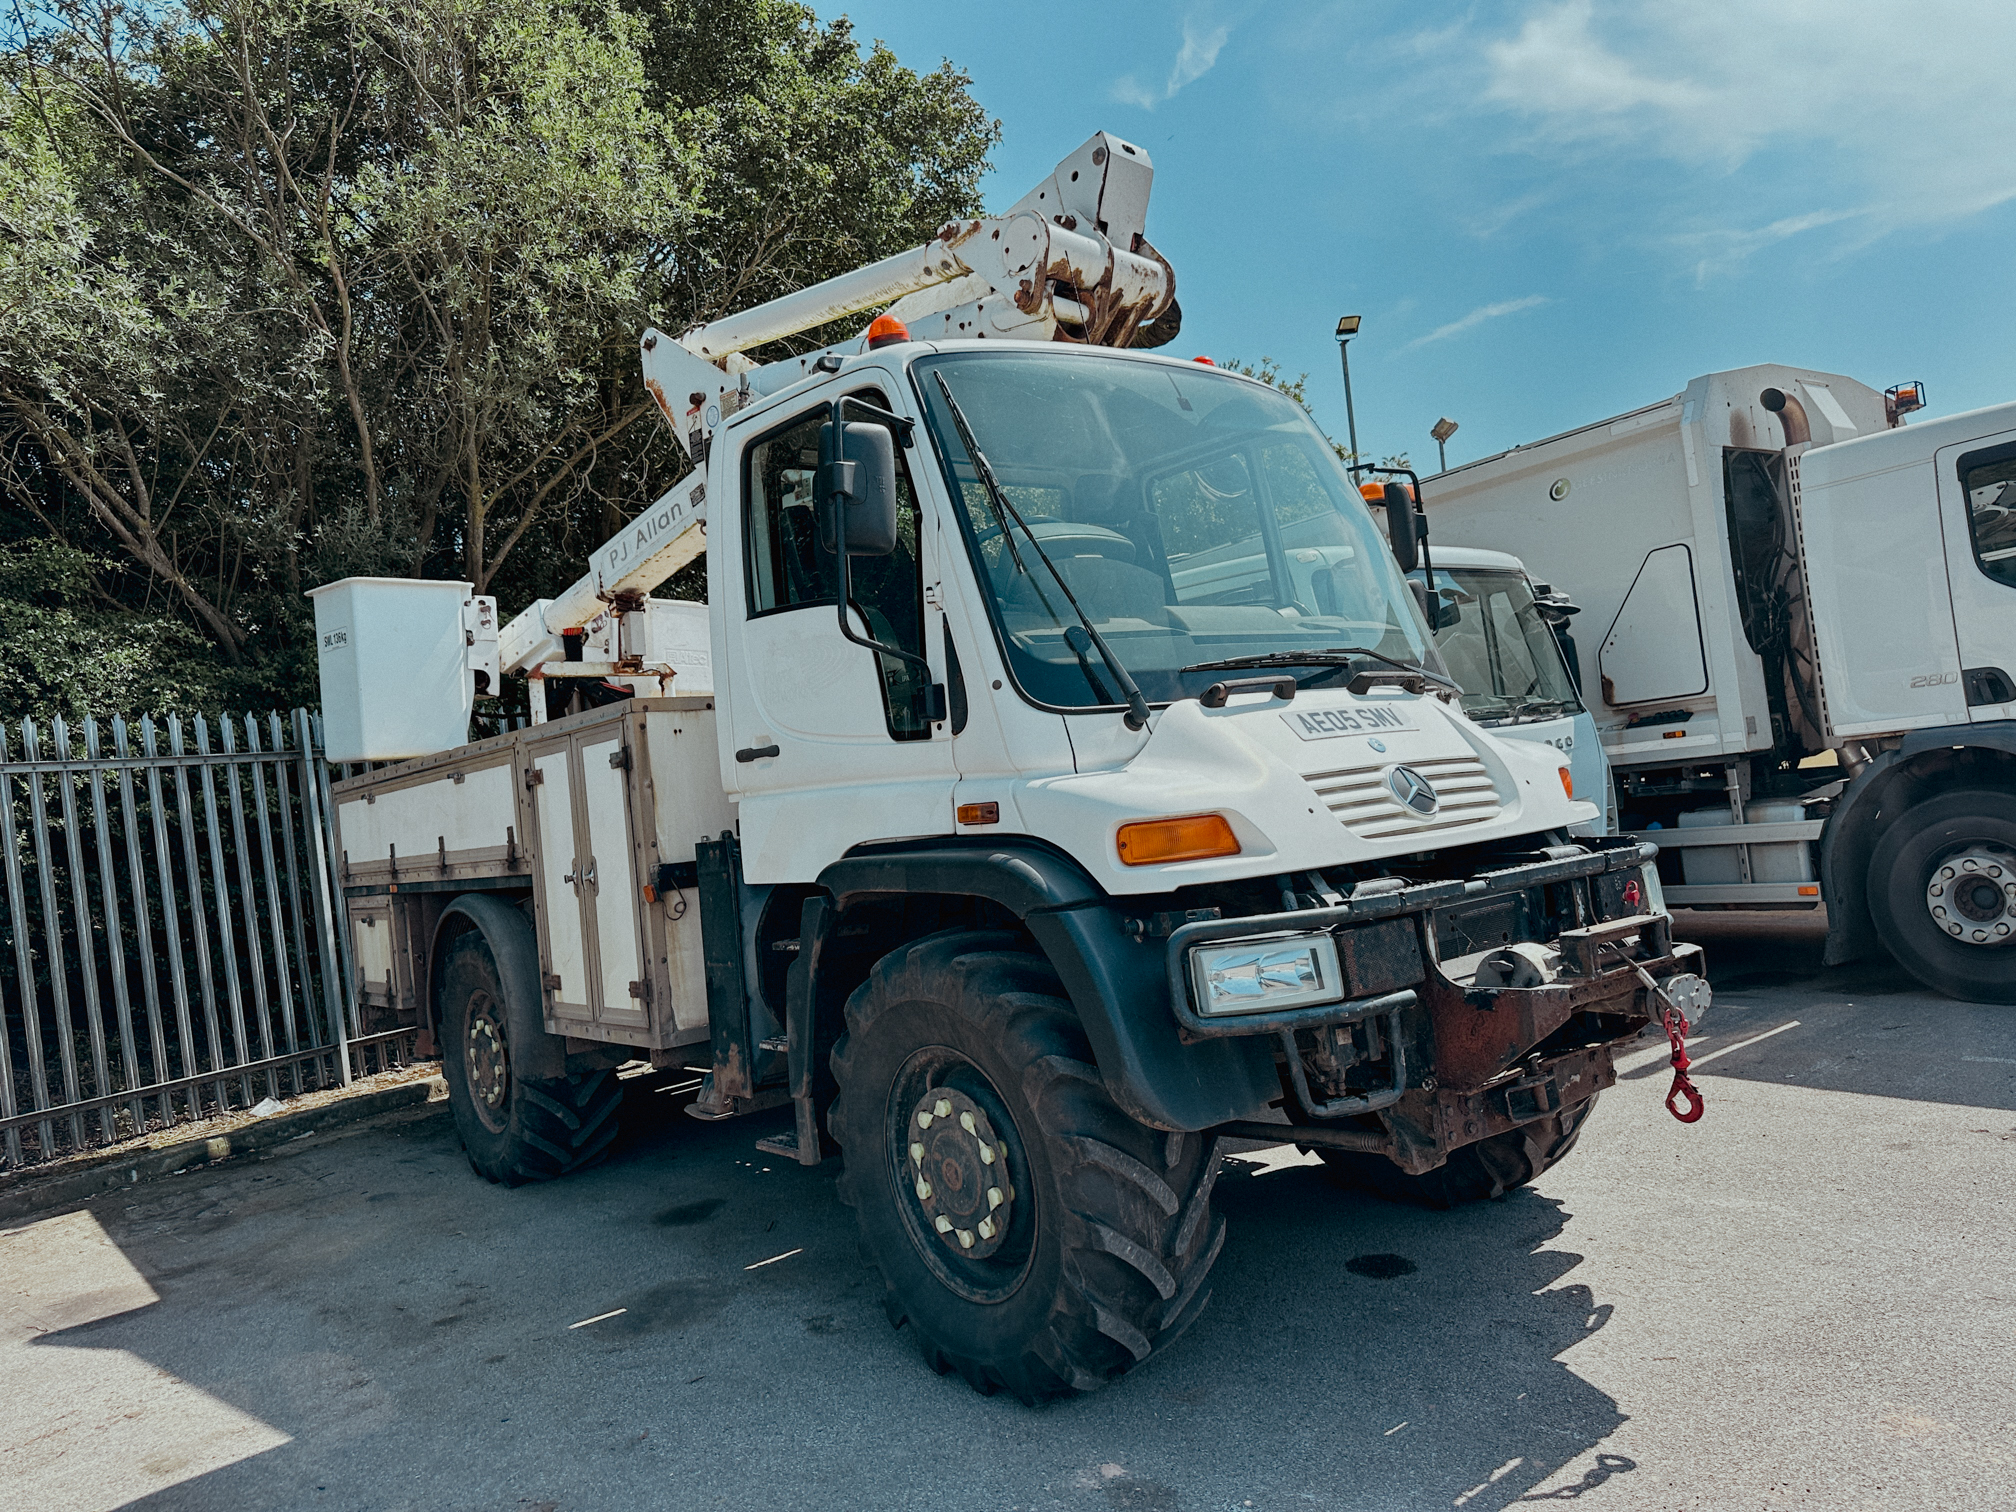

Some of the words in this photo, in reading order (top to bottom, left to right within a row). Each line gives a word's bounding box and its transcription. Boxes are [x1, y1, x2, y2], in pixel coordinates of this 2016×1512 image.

[609, 540, 628, 569] PJ
[636, 503, 682, 550] Allan
[323, 634, 333, 647] SWL
[1910, 671, 1959, 688] 280
[1297, 710, 1362, 734] AE05
[1355, 707, 1404, 728] SMV
